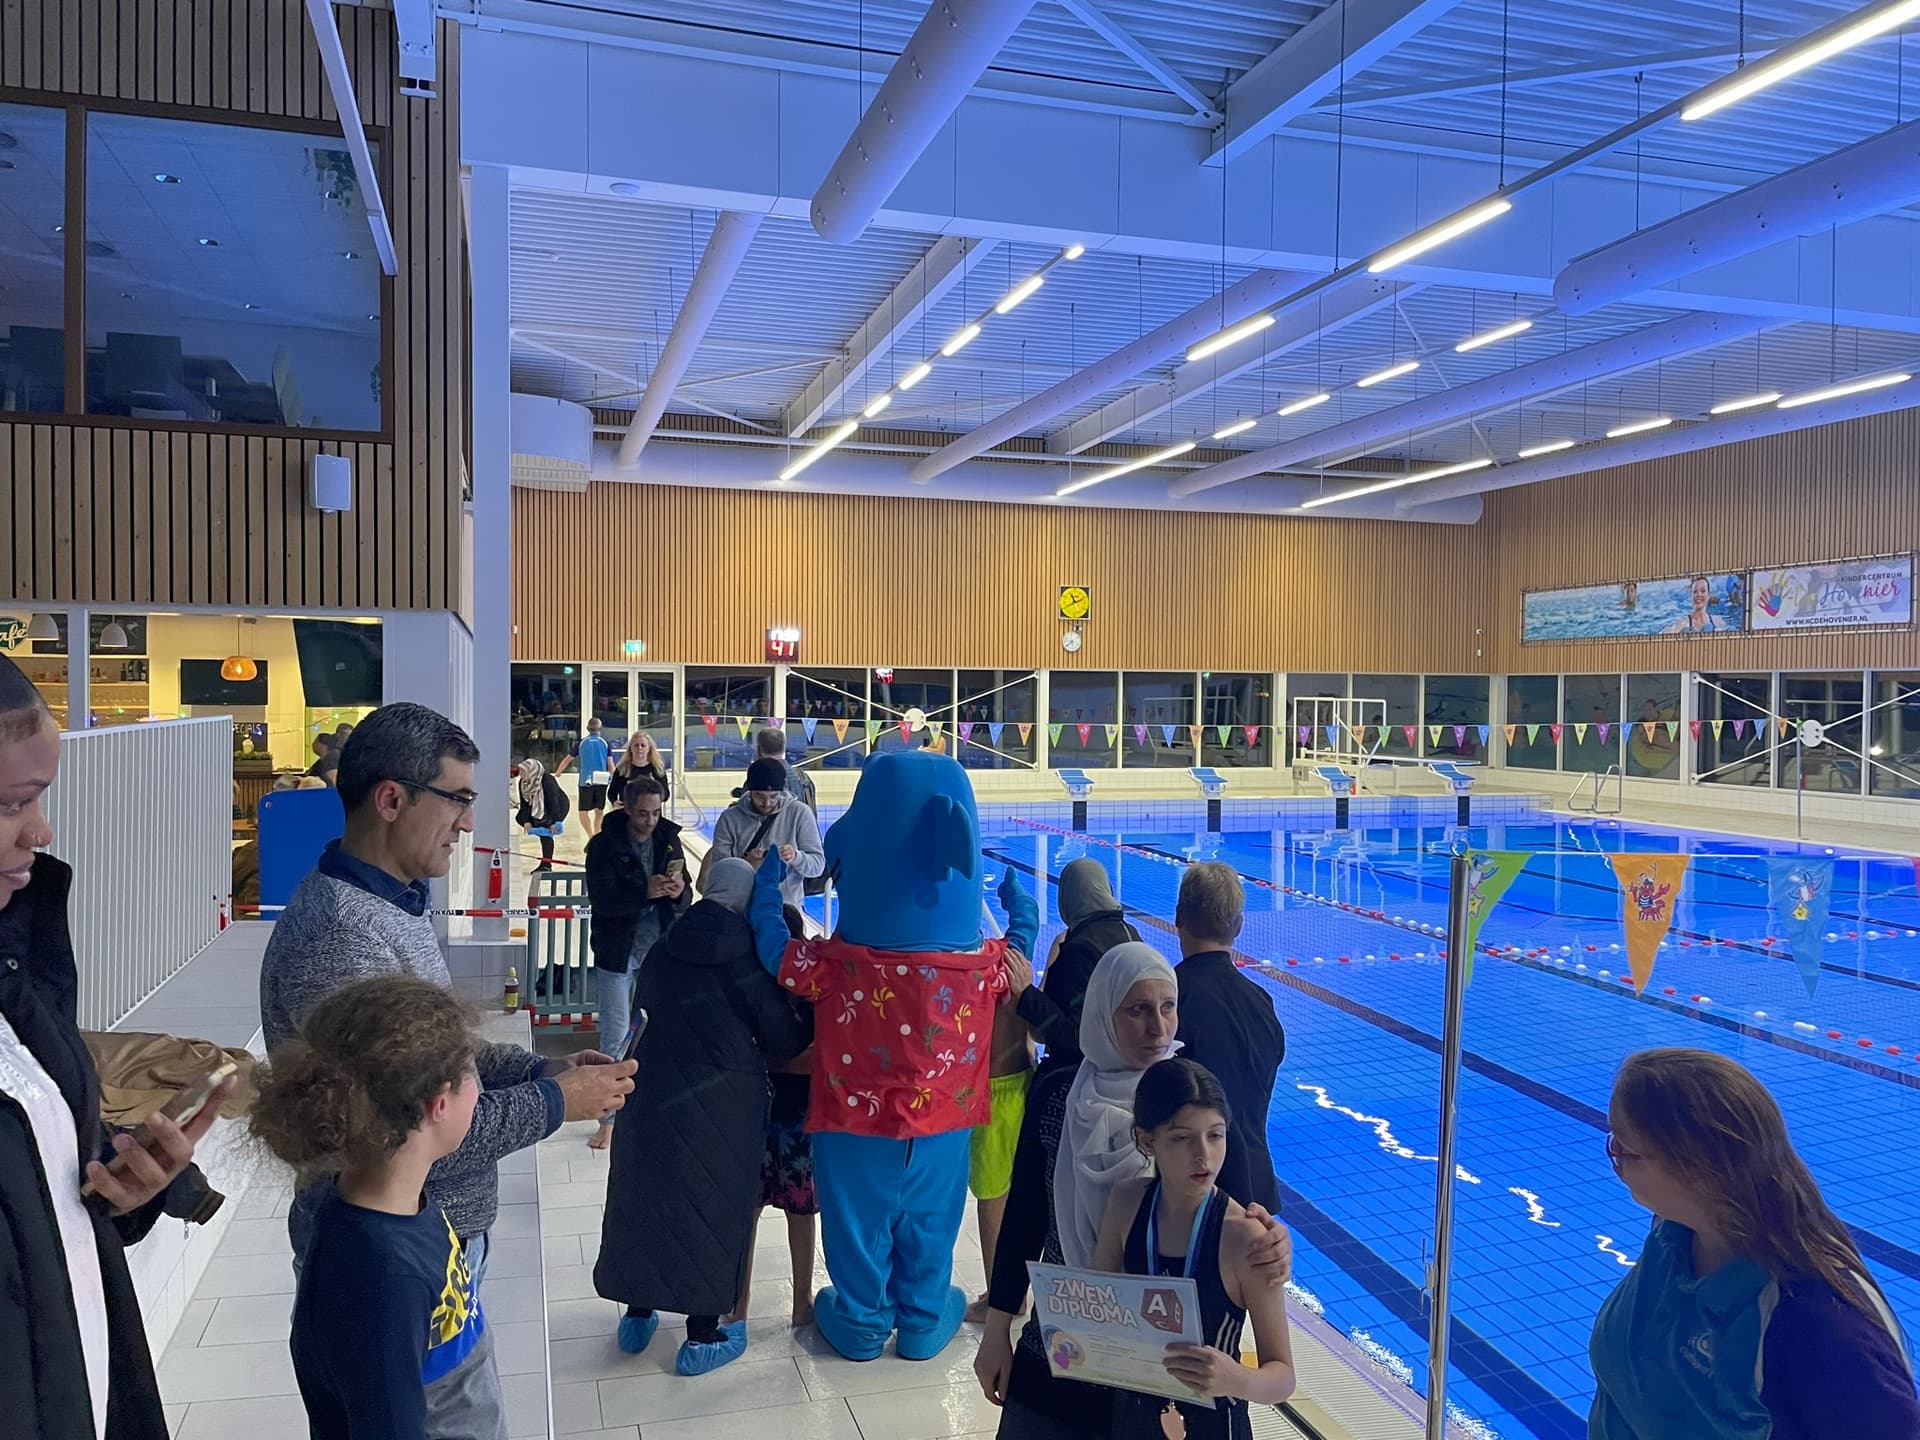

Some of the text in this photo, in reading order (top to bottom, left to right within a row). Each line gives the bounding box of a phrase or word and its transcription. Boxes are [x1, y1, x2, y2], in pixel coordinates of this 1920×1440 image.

[1841, 572, 1903, 583] KINDERCENTRUM
[0, 622, 28, 650] afé
[771, 641, 795, 657] 41
[233, 722, 262, 736] PECIALS
[1053, 1279, 1117, 1304] ZWEM
[1048, 1295, 1138, 1328] DIPLOMA
[1147, 1293, 1168, 1316] A
